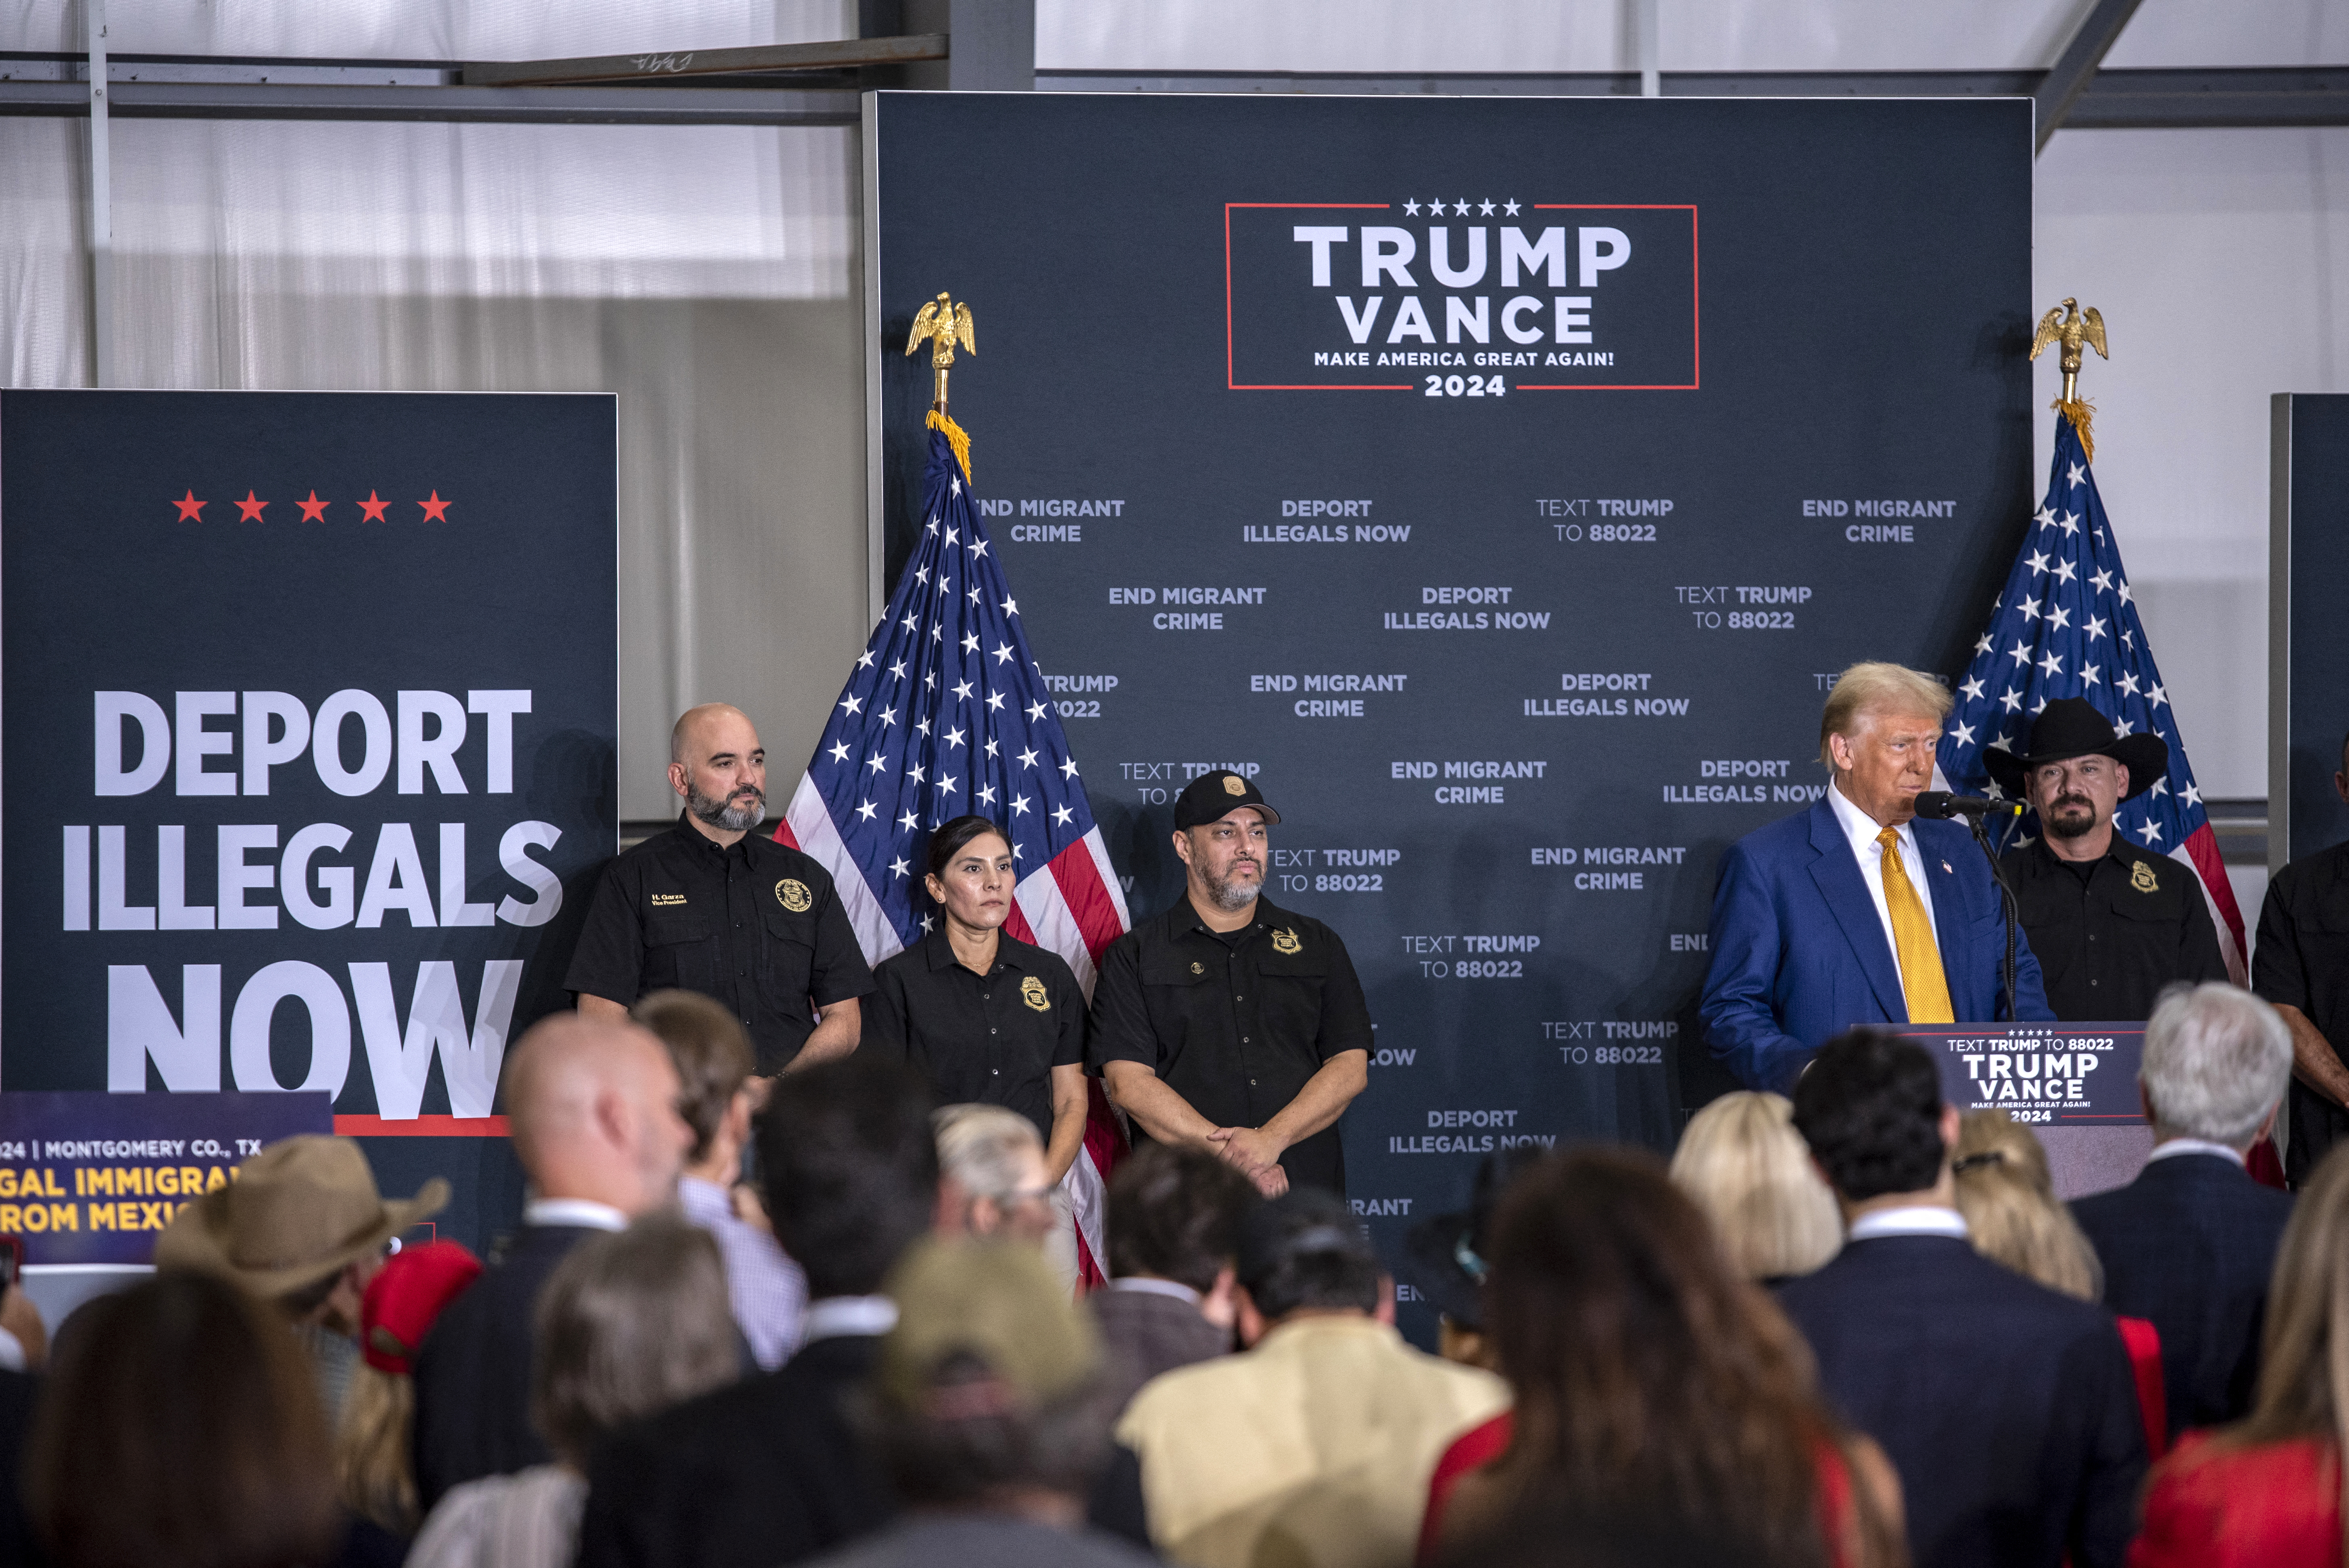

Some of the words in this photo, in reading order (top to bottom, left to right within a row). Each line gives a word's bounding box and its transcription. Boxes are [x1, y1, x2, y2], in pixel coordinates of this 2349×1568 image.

[1294, 226, 1631, 288] TRUMP
[1336, 296, 1592, 344] VANCE
[1315, 352, 1369, 365] MAKE
[1377, 352, 1467, 366] AMERICA
[1474, 352, 1537, 366] GREAT
[1545, 352, 1613, 366] AGAIN!
[1425, 375, 1505, 396] 2024
[975, 500, 1013, 515] ND
[1021, 500, 1124, 516] MIGRANT
[1282, 500, 1372, 517] DEPORT
[1536, 499, 1590, 516] TEXT
[1597, 500, 1673, 516] TRUMP
[1803, 500, 1848, 516] END
[1855, 500, 1956, 517] MIGRANT
[1011, 525, 1081, 542] CRIME
[1244, 525, 1348, 542] ILLEGALS
[1356, 525, 1410, 542] NOW
[1554, 524, 1582, 542] TO
[1590, 525, 1656, 541] 88022
[1846, 525, 1913, 542] CRIME
[1110, 588, 1156, 604] END
[1163, 588, 1266, 604] MIGRANT
[1423, 587, 1512, 604] DEPORT
[1675, 586, 1728, 603] TEXT
[1736, 587, 1811, 603] TRUMP
[1153, 613, 1222, 630] CRIME
[1385, 613, 1488, 629] ILLEGALS
[1496, 612, 1550, 629] NOW
[1693, 611, 1721, 629] TO
[1728, 612, 1794, 628] 88022
[1041, 676, 1118, 692] TRUMP
[1251, 675, 1297, 691] END
[1304, 675, 1407, 691] MIGRANT
[1563, 674, 1651, 690] DEPORT
[1295, 700, 1364, 717] CRIME
[1525, 699, 1627, 716] ILLEGALS
[1635, 699, 1689, 715] NOW
[95, 689, 532, 797] DEPORT
[1120, 763, 1175, 780] TEXT
[1392, 762, 1437, 778] END
[1445, 761, 1547, 778] MIGRANT
[1701, 760, 1790, 777] DEPORT
[1137, 787, 1167, 805] TO
[1435, 787, 1504, 803] CRIME
[1664, 786, 1767, 802] ILLEGALS
[1774, 785, 1827, 802] NOW
[1323, 849, 1400, 866] TRUMP
[1531, 848, 1577, 864] END
[1584, 848, 1686, 864] MIGRANT
[64, 821, 562, 930] ILLEGALS
[1279, 875, 1308, 892] TO
[1316, 874, 1383, 891] 88022
[1575, 873, 1643, 890] CRIME
[1402, 936, 1456, 953] TEXT
[1463, 936, 1540, 952] TRUMP
[1419, 961, 1448, 978] TO
[1456, 961, 1522, 978] 88022
[1542, 1021, 1596, 1039] TEXT
[1603, 1022, 1679, 1038] TRUMP
[108, 960, 524, 1120] NOW
[1947, 1040, 1984, 1051] TEXT
[1989, 1039, 2040, 1051] TRUMP
[2044, 1039, 2063, 1051] TO
[2068, 1039, 2113, 1050] 88022
[1560, 1047, 1588, 1064] TO
[1595, 1047, 1661, 1064] 88022
[1963, 1054, 2098, 1079] TRUMP
[1978, 1080, 2083, 1100] VANCE
[1428, 1110, 1517, 1127] DEPORT
[2011, 1110, 2051, 1122] 2024
[45, 1140, 186, 1158] MONTGOMERY
[236, 1139, 262, 1156] TX
[1390, 1136, 1494, 1153] ILLEGALS
[1501, 1135, 1556, 1150] NOW
[89, 1202, 190, 1231] MEXI
